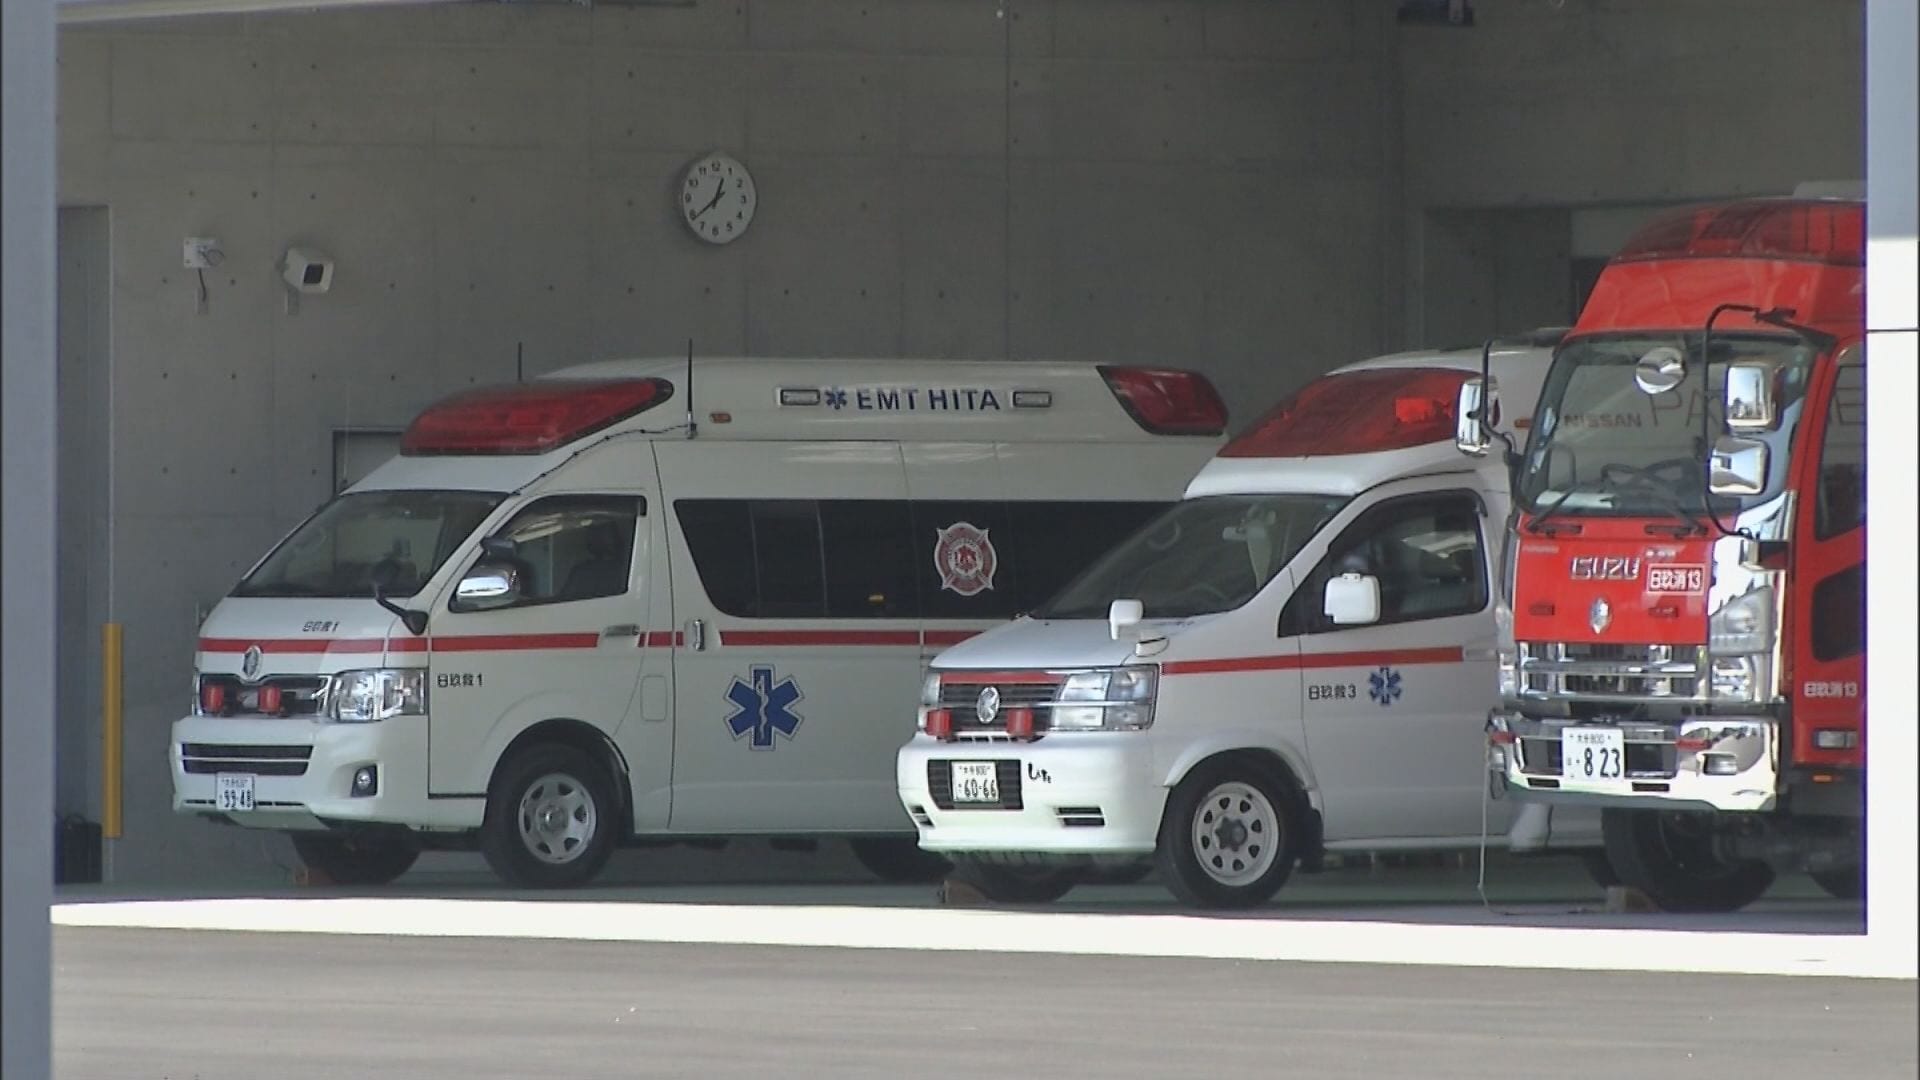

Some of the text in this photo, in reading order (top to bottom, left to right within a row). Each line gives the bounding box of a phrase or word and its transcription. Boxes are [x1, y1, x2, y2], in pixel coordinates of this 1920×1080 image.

[857, 389, 1001, 411] EMT HITA
[1564, 413, 1642, 428] NISSAN
[1571, 557, 1641, 580] ISUZU
